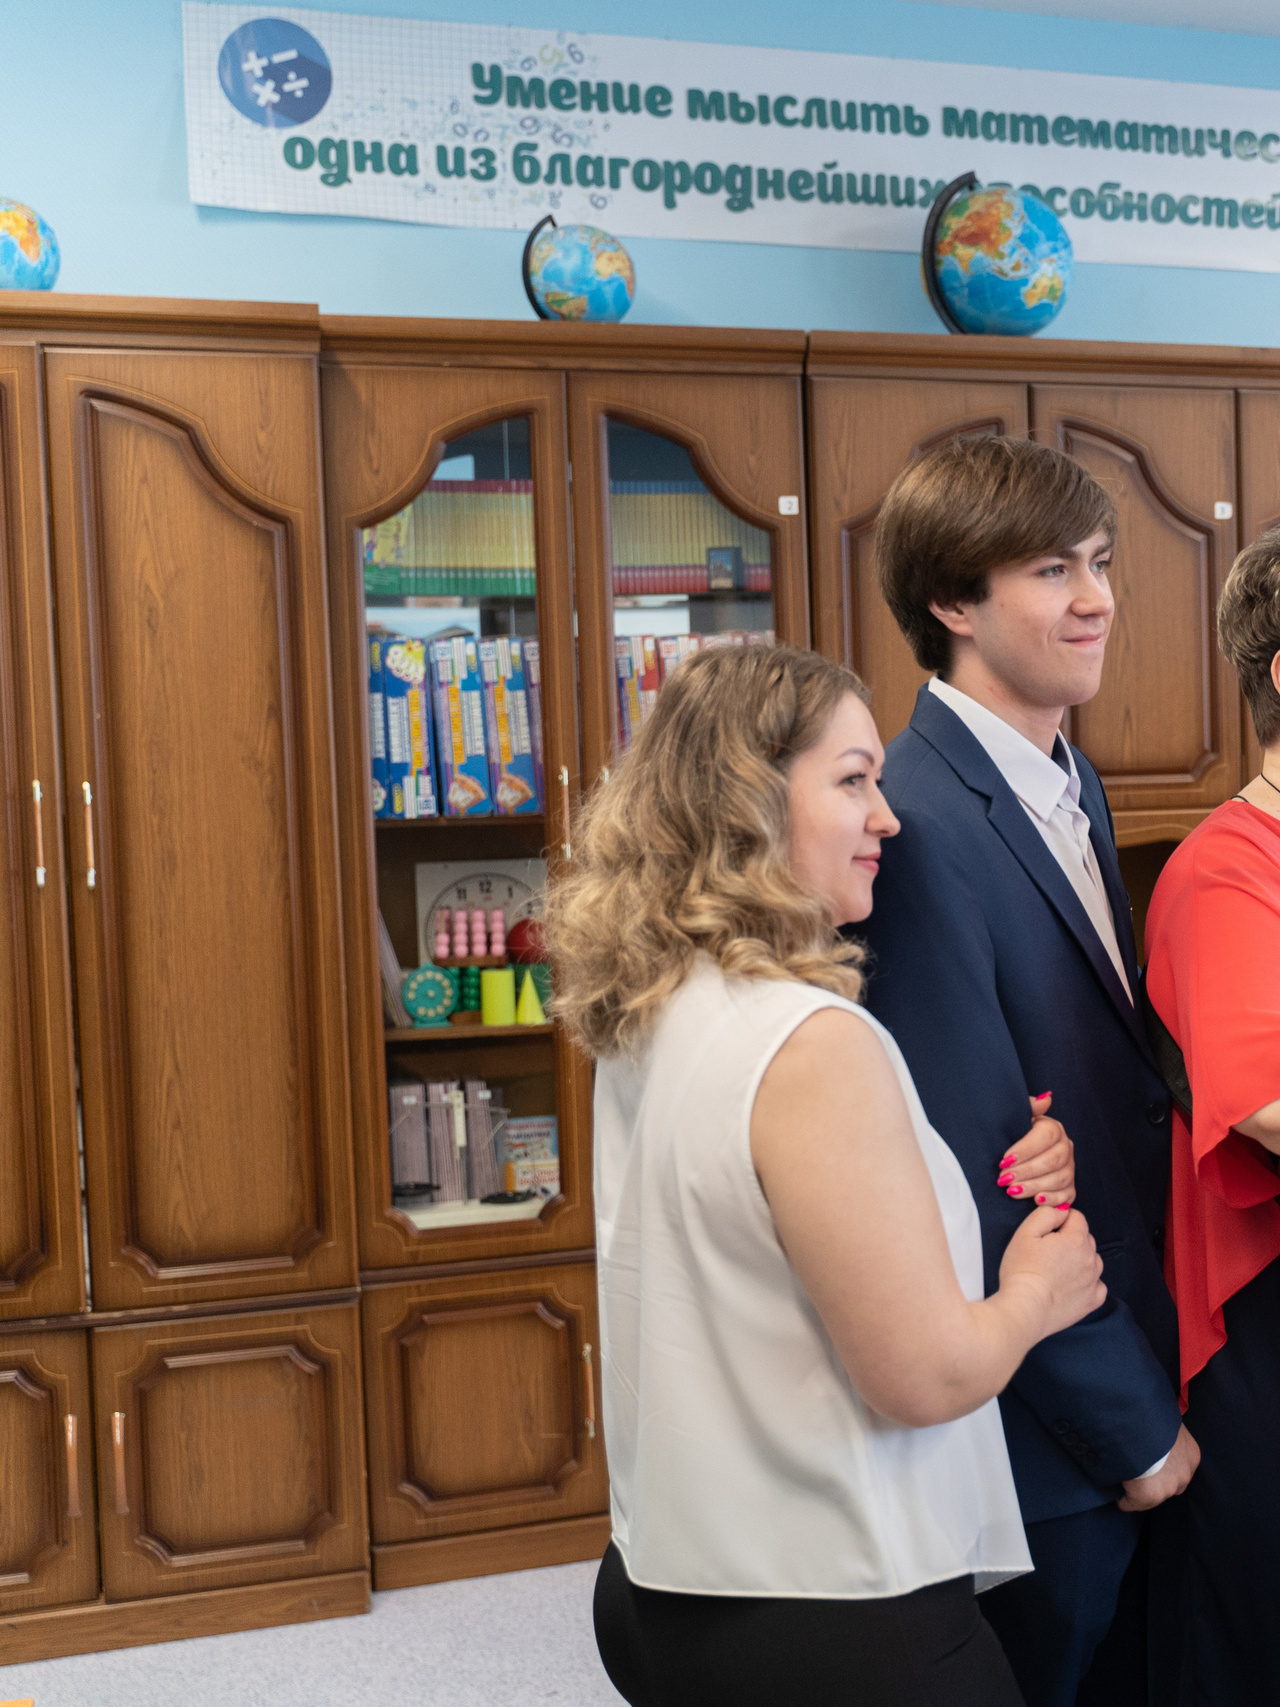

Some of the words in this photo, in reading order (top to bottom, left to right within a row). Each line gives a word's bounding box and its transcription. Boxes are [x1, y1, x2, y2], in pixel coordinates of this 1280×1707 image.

[472, 63, 673, 118] Умение
[688, 90, 931, 138] мыслить
[284, 137, 419, 188] одна
[437, 146, 498, 182] из
[457, 887, 467, 900] 11
[479, 881, 492, 894] 12
[508, 886, 513, 899] 1
